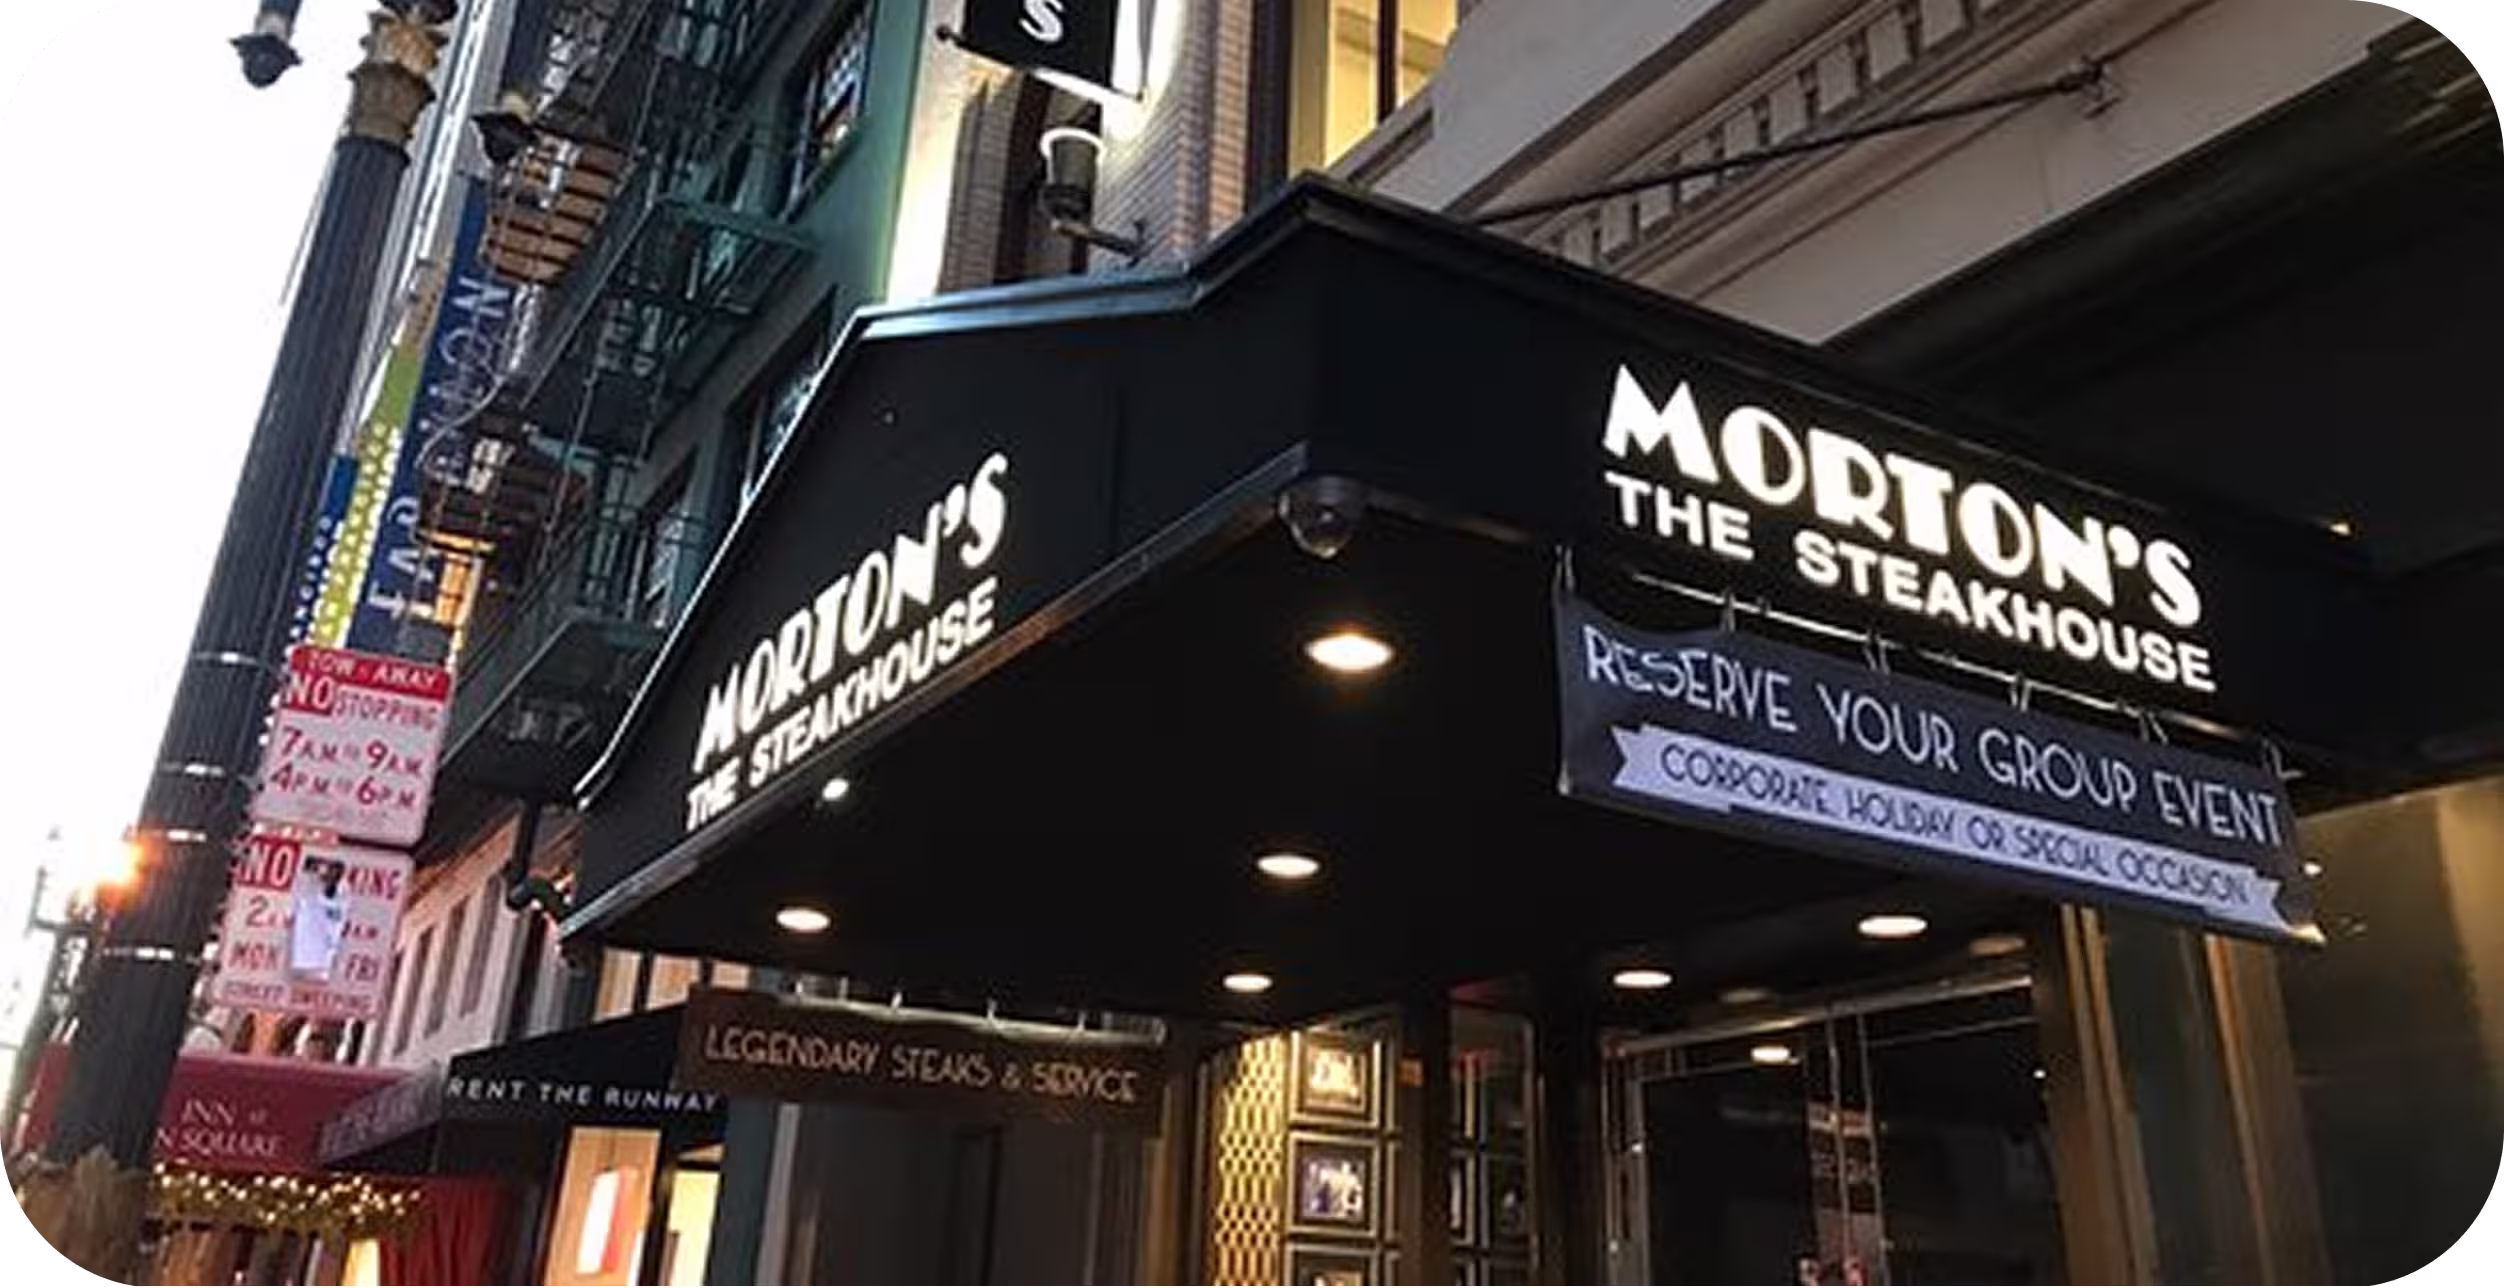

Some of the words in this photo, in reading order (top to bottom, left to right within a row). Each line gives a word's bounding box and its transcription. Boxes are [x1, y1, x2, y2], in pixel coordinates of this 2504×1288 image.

[1604, 364, 2201, 627] MORTON'S
[692, 453, 1008, 774] MORTON'S
[1605, 471, 1754, 561] THE
[1794, 530, 2216, 692] STEAKHOUSE
[289, 672, 335, 709] NO
[686, 757, 741, 832] THE
[748, 576, 998, 789] STEAKHOUSE
[1584, 624, 1797, 733] RESERVE
[1815, 682, 1960, 774] YOUR
[1978, 728, 2137, 812] GROUP
[2152, 770, 2281, 847] EVENT
[246, 841, 294, 890] NO
[1846, 788, 1954, 840] HOLIDAY
[1966, 814, 2006, 852] OR
[2014, 824, 2108, 877] SPECIAL
[2116, 849, 2248, 903] OCCASION
[182, 1099, 236, 1126] INN
[448, 1077, 527, 1101] RENT
[539, 1083, 593, 1106] THE
[604, 1086, 720, 1111] RUNWAY
[704, 1026, 880, 1074] LEGENDARY
[892, 1047, 992, 1088] STEAKS
[1001, 1065, 1020, 1089] &
[1033, 1063, 1139, 1101] SERVICE
